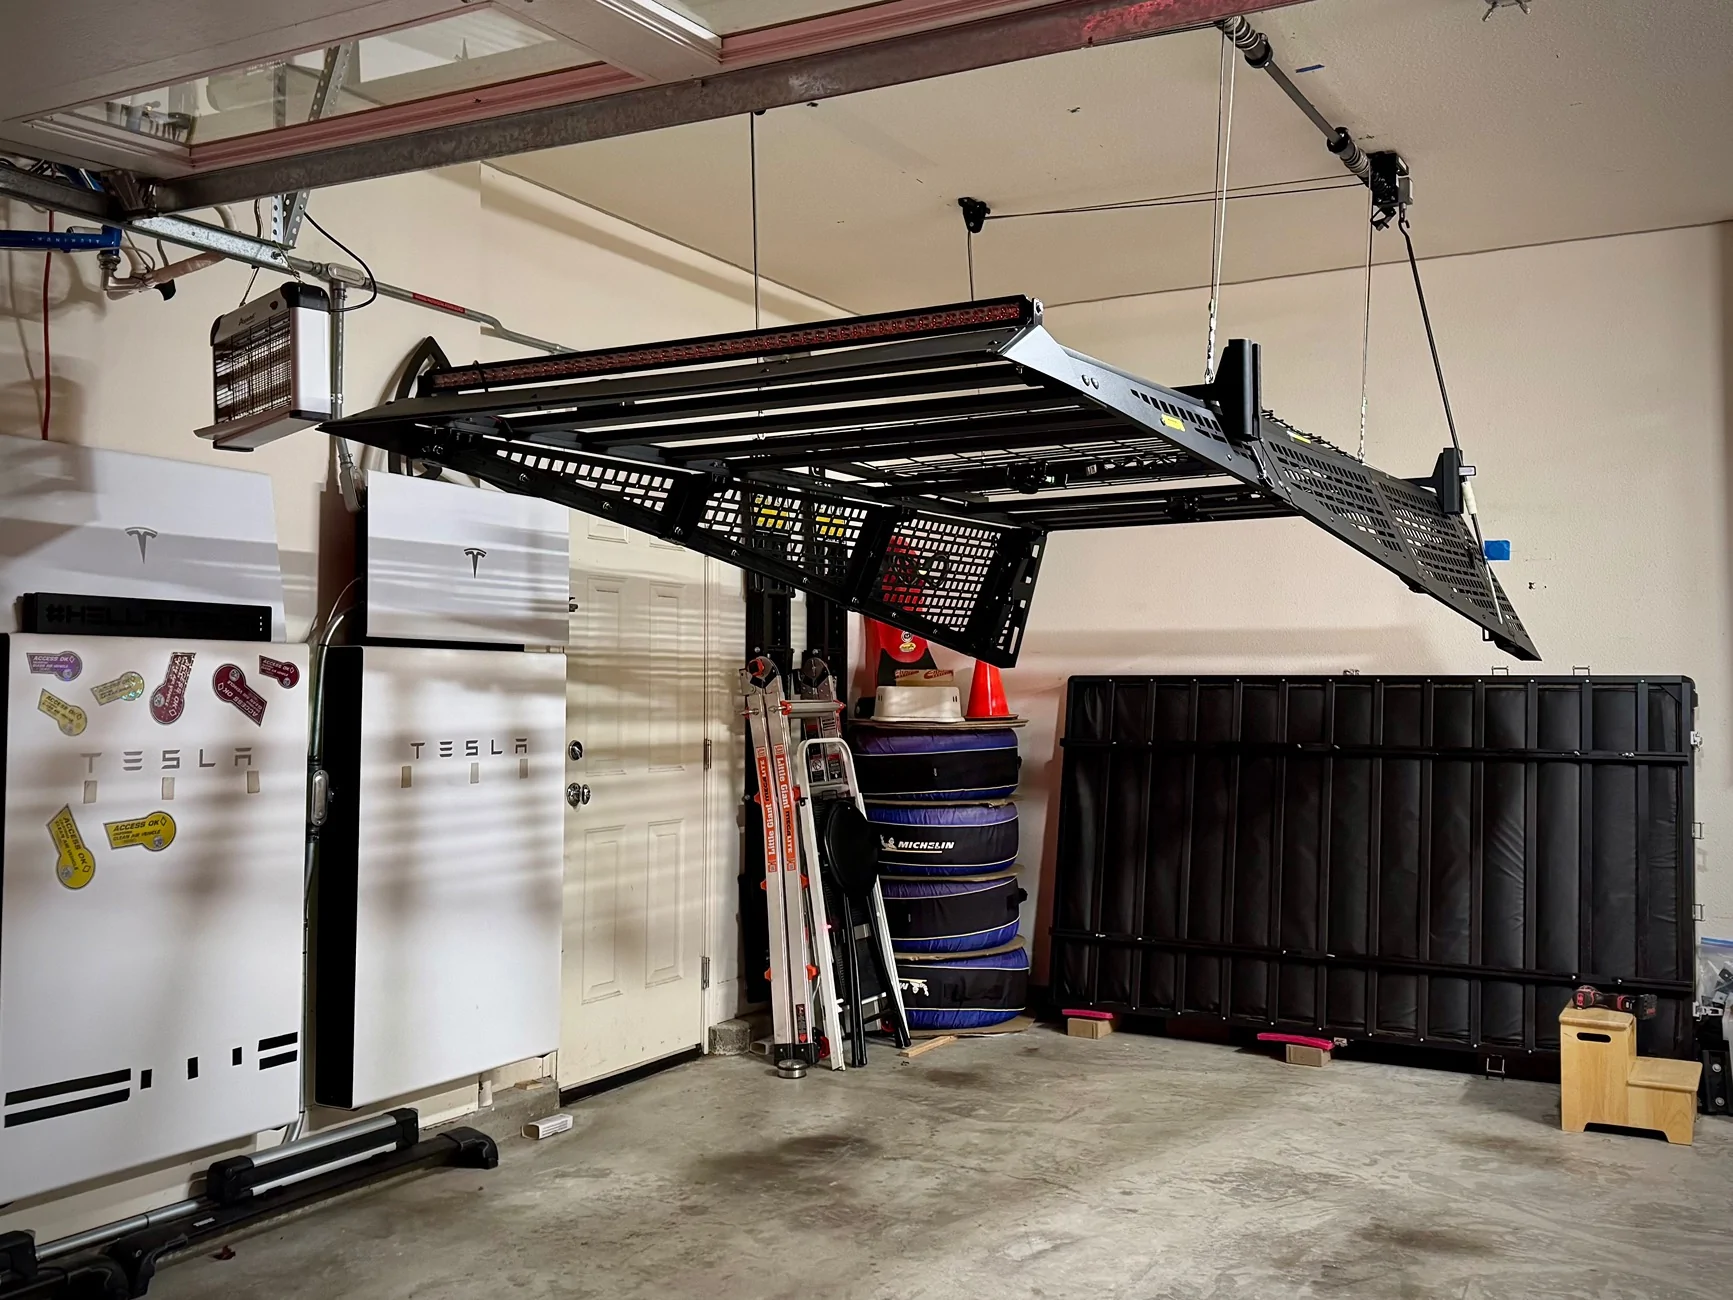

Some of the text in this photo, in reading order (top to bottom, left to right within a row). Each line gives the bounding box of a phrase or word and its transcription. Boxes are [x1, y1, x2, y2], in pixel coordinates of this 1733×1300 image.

[263, 659, 283, 669] ACCESS
[46, 695, 69, 711] ACCESS
[171, 696, 180, 710] OK
[223, 687, 234, 697] OK
[232, 695, 260, 718] ACCESS
[410, 738, 528, 759] TESLA
[80, 747, 252, 773] TESLA
[776, 758, 786, 782] Little
[780, 784, 790, 809] Giant
[113, 819, 162, 832] ACCESS OK
[765, 803, 774, 828] Giant
[61, 816, 83, 851] ACCESS
[77, 852, 88, 866] OK
[767, 830, 776, 856] Little
[897, 840, 955, 849] MICHELIN
